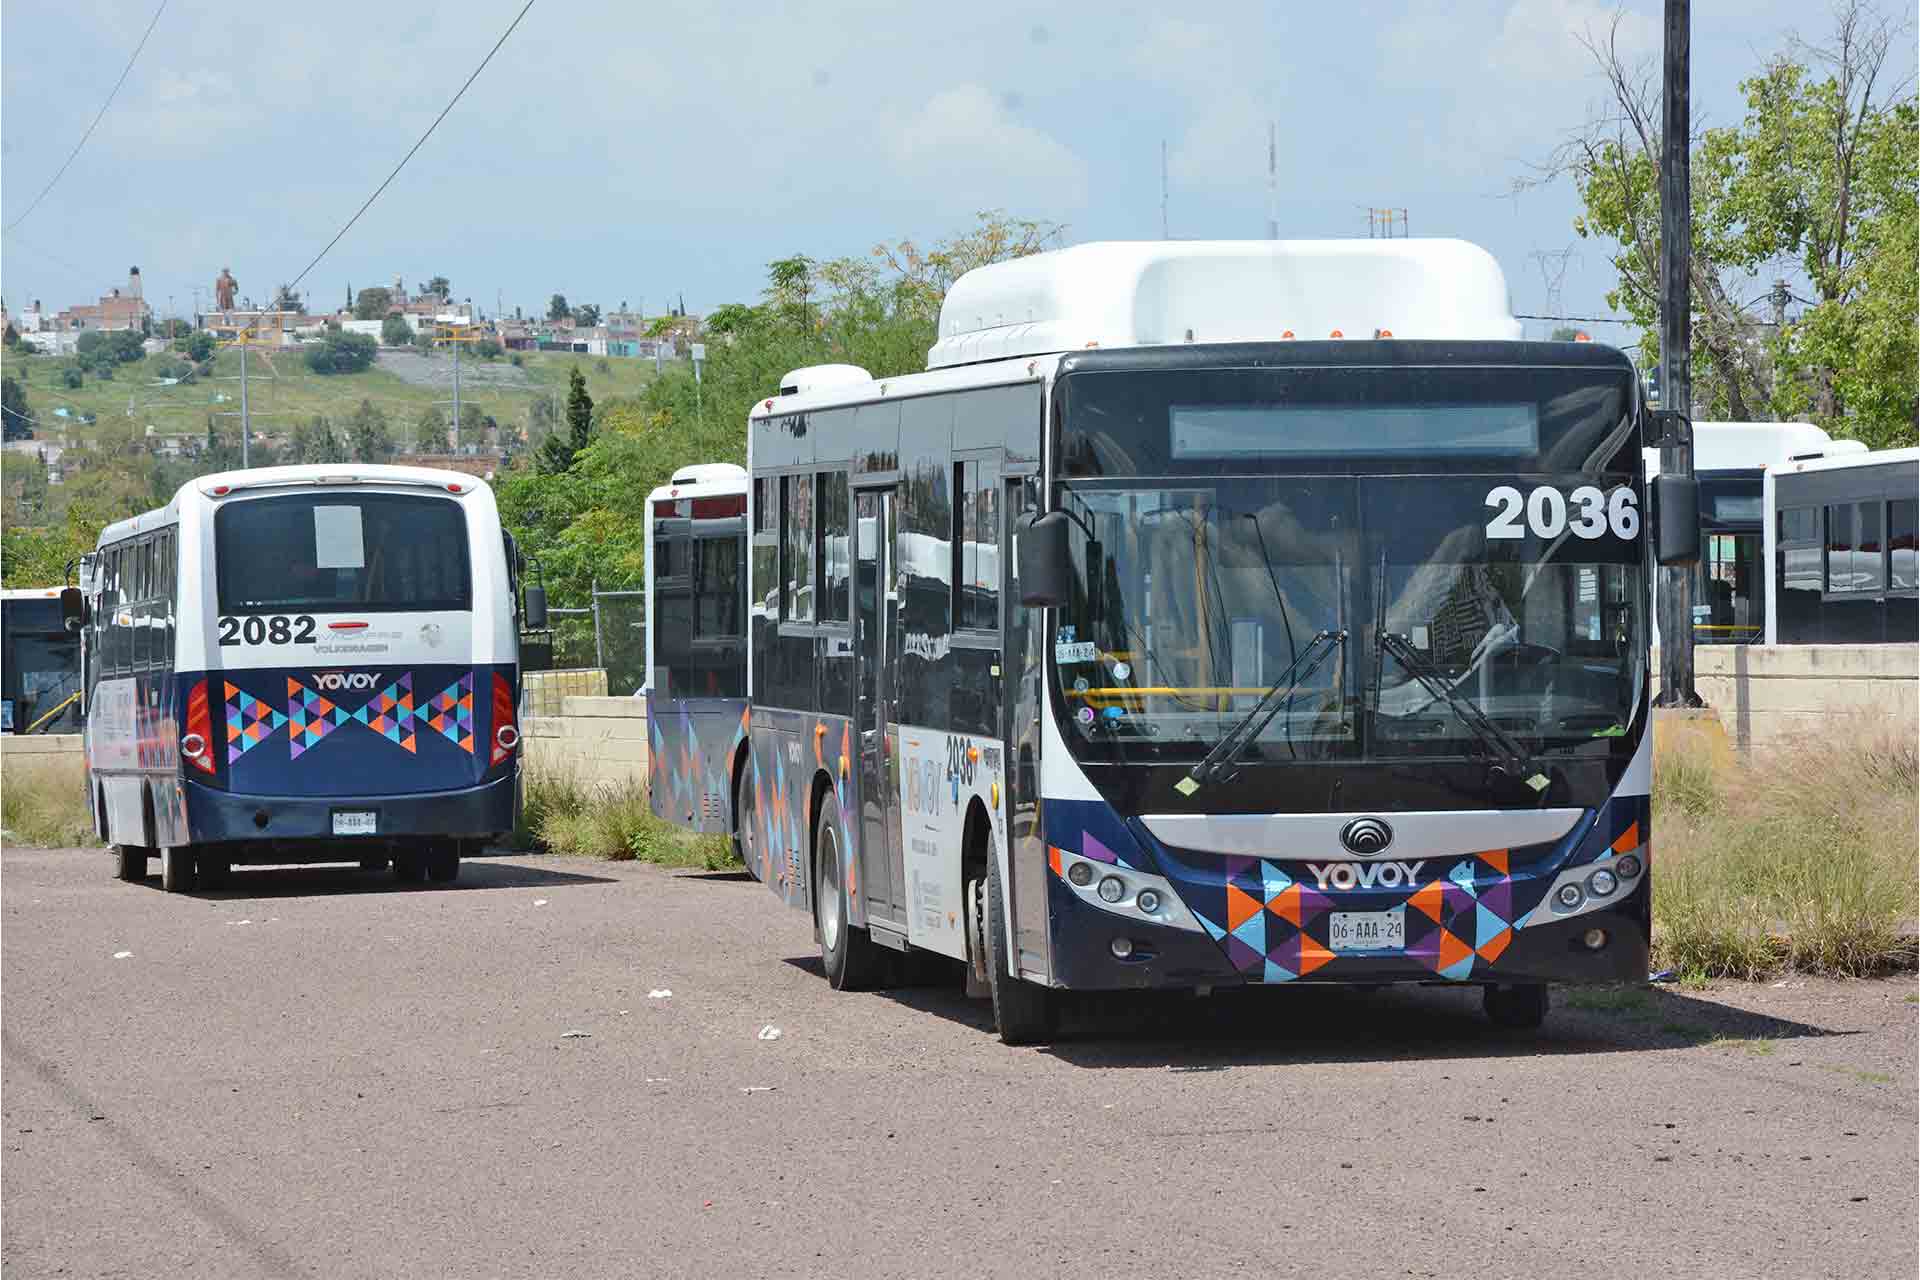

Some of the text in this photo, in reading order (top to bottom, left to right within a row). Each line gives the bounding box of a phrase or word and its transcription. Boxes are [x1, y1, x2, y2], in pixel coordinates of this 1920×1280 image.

[1485, 486, 1640, 540] 2036
[218, 616, 317, 646] 2082
[312, 673, 381, 690] YOVOY
[1305, 861, 1425, 890] YOVOY
[1332, 922, 1402, 938] 06-AAA-24
